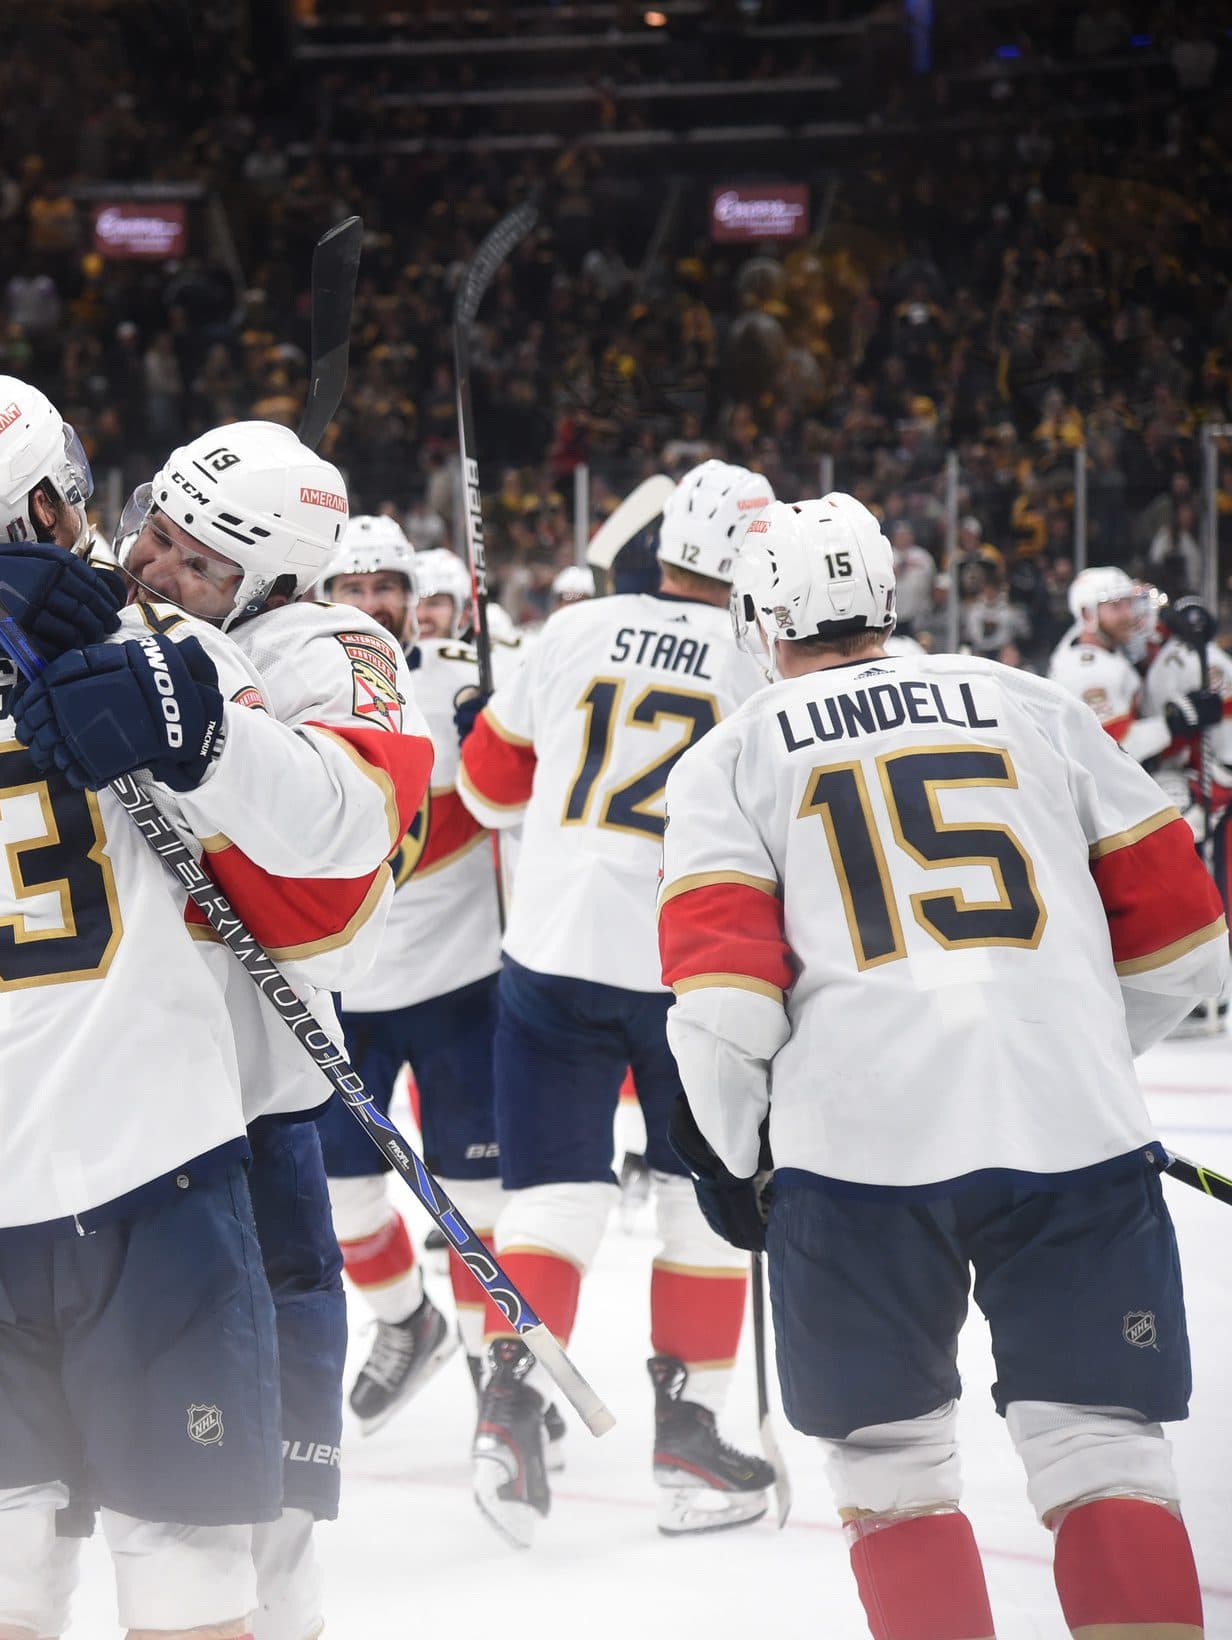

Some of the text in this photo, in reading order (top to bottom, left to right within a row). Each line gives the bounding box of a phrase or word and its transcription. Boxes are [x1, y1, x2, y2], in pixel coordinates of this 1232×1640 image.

[203, 447, 241, 471] 19
[171, 471, 211, 506] CCM
[300, 487, 348, 513] AMERANT
[682, 543, 701, 564] 12
[825, 552, 852, 579] 15
[611, 628, 712, 680] STAAL
[777, 681, 998, 753] LUNDELL
[200, 720, 216, 757] TKACHUK
[561, 675, 721, 843] 12
[797, 744, 1048, 972] 15
[1130, 1319, 1150, 1339] NHL
[194, 1413, 217, 1437] NHL
